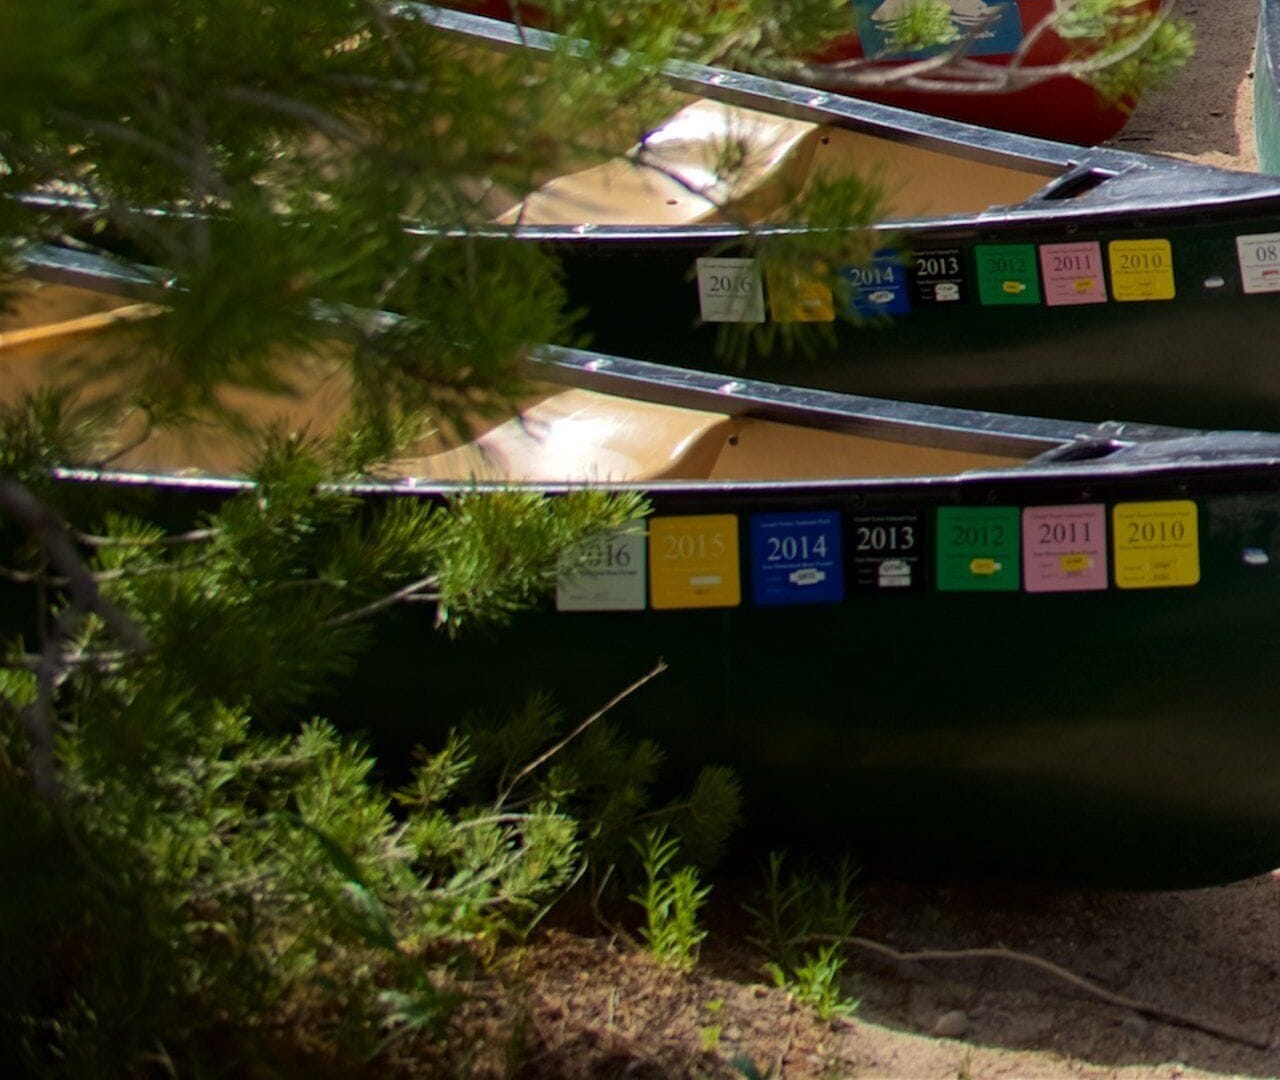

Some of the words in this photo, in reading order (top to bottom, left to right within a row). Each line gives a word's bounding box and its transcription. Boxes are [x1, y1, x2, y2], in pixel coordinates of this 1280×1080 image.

[1053, 254, 1092, 272] 2011
[1119, 253, 1164, 270] 2010
[1255, 244, 1280, 262] 08
[849, 266, 895, 287] 2014
[916, 257, 960, 276] 2013
[856, 525, 915, 552] 2013
[952, 523, 1006, 547] 2012
[1039, 521, 1092, 545] 2011
[1126, 520, 1186, 544] 2010
[664, 533, 727, 561] 2015
[766, 534, 829, 562] 2014
